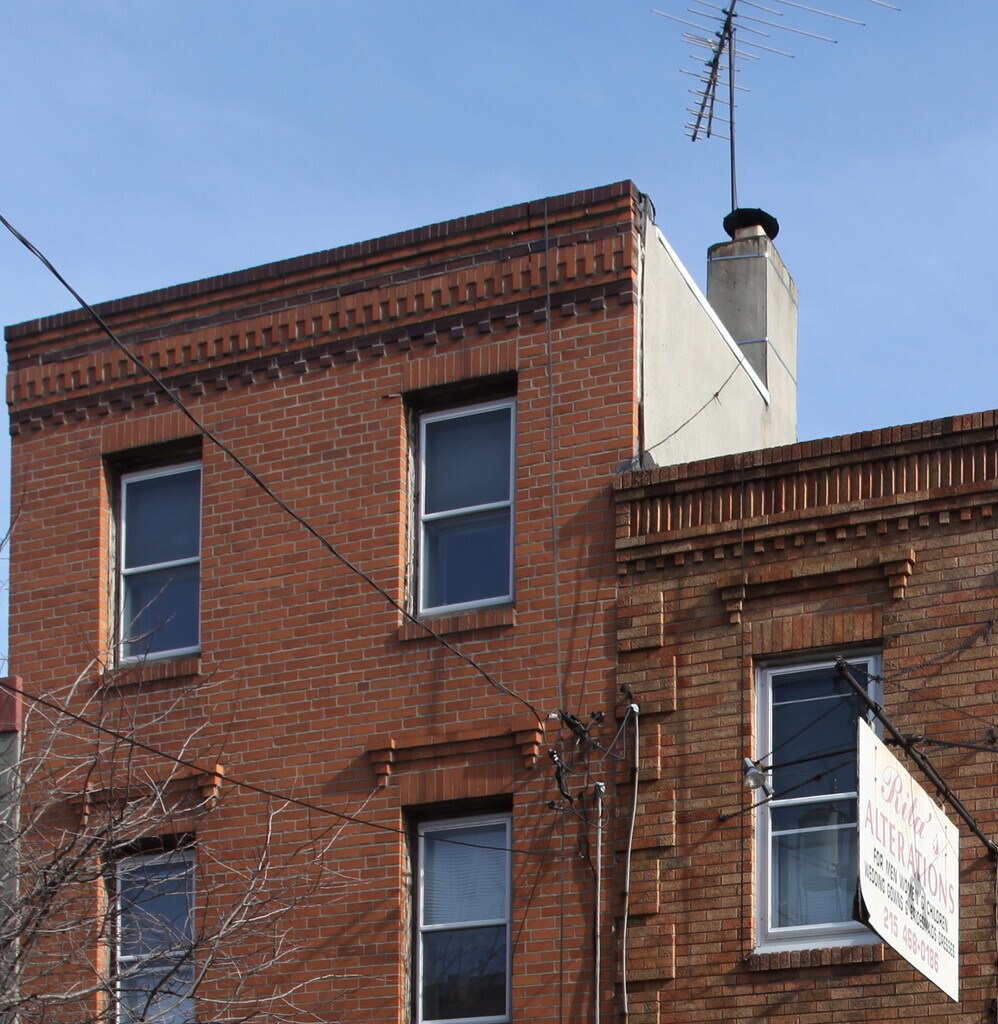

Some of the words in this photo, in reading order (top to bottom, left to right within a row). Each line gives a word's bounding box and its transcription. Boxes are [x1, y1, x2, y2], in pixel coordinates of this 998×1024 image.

[880, 766, 940, 855] Rita's
[864, 800, 955, 915] ALTERATIONS
[873, 848, 884, 871] FOR
[886, 860, 898, 884] MEN
[926, 900, 949, 933] CHILDREN
[864, 860, 885, 894] WEDDING
[887, 882, 904, 911] GOWNS
[938, 931, 956, 959] DRESSES
[883, 906, 898, 938] 215
